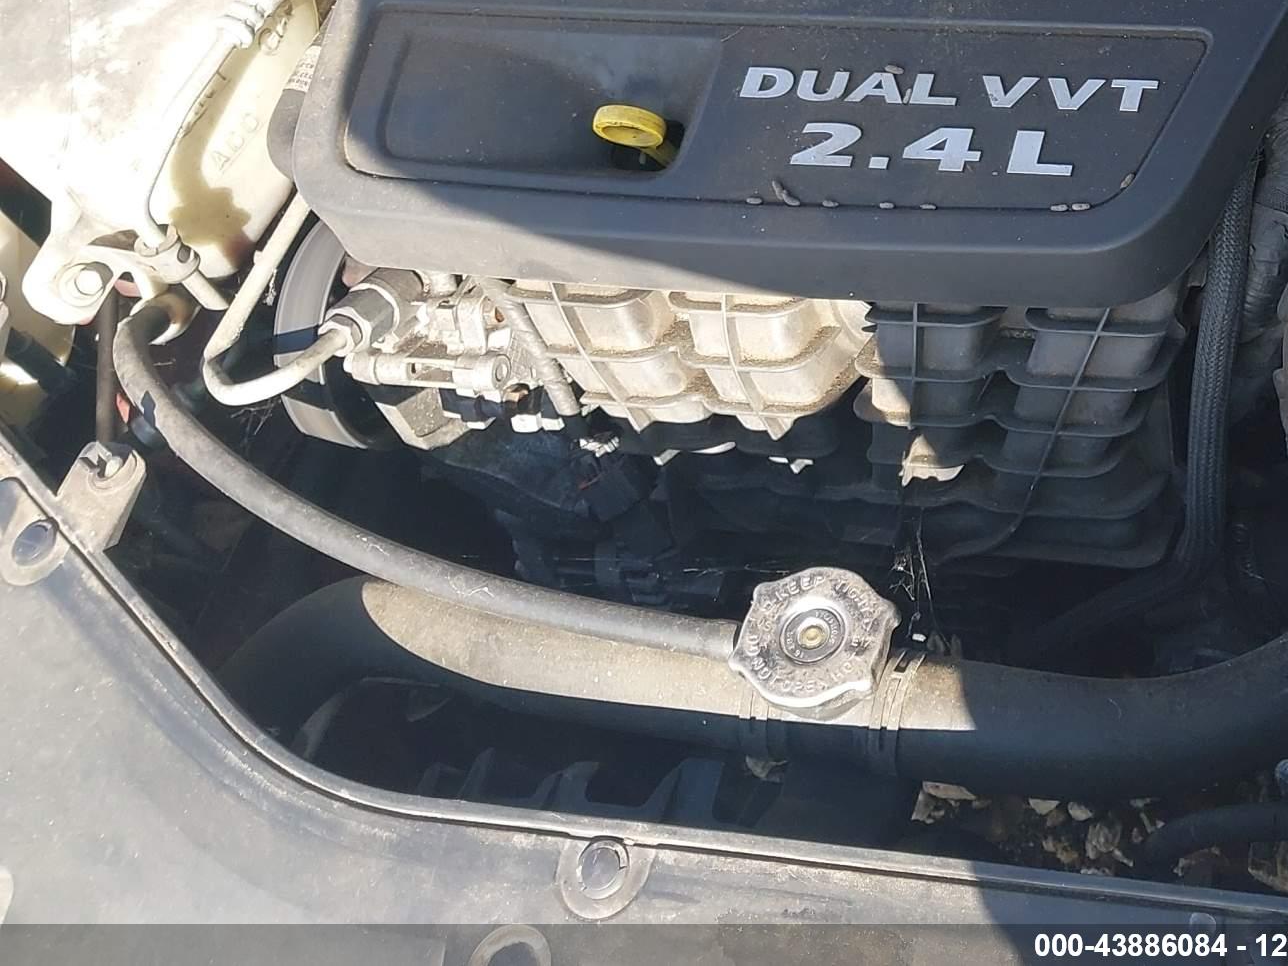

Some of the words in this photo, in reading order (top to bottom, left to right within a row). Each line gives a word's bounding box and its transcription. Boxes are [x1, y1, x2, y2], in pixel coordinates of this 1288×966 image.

[739, 66, 958, 107] DUAL
[982, 75, 1160, 112] VVT
[775, 574, 826, 602] KEEP
